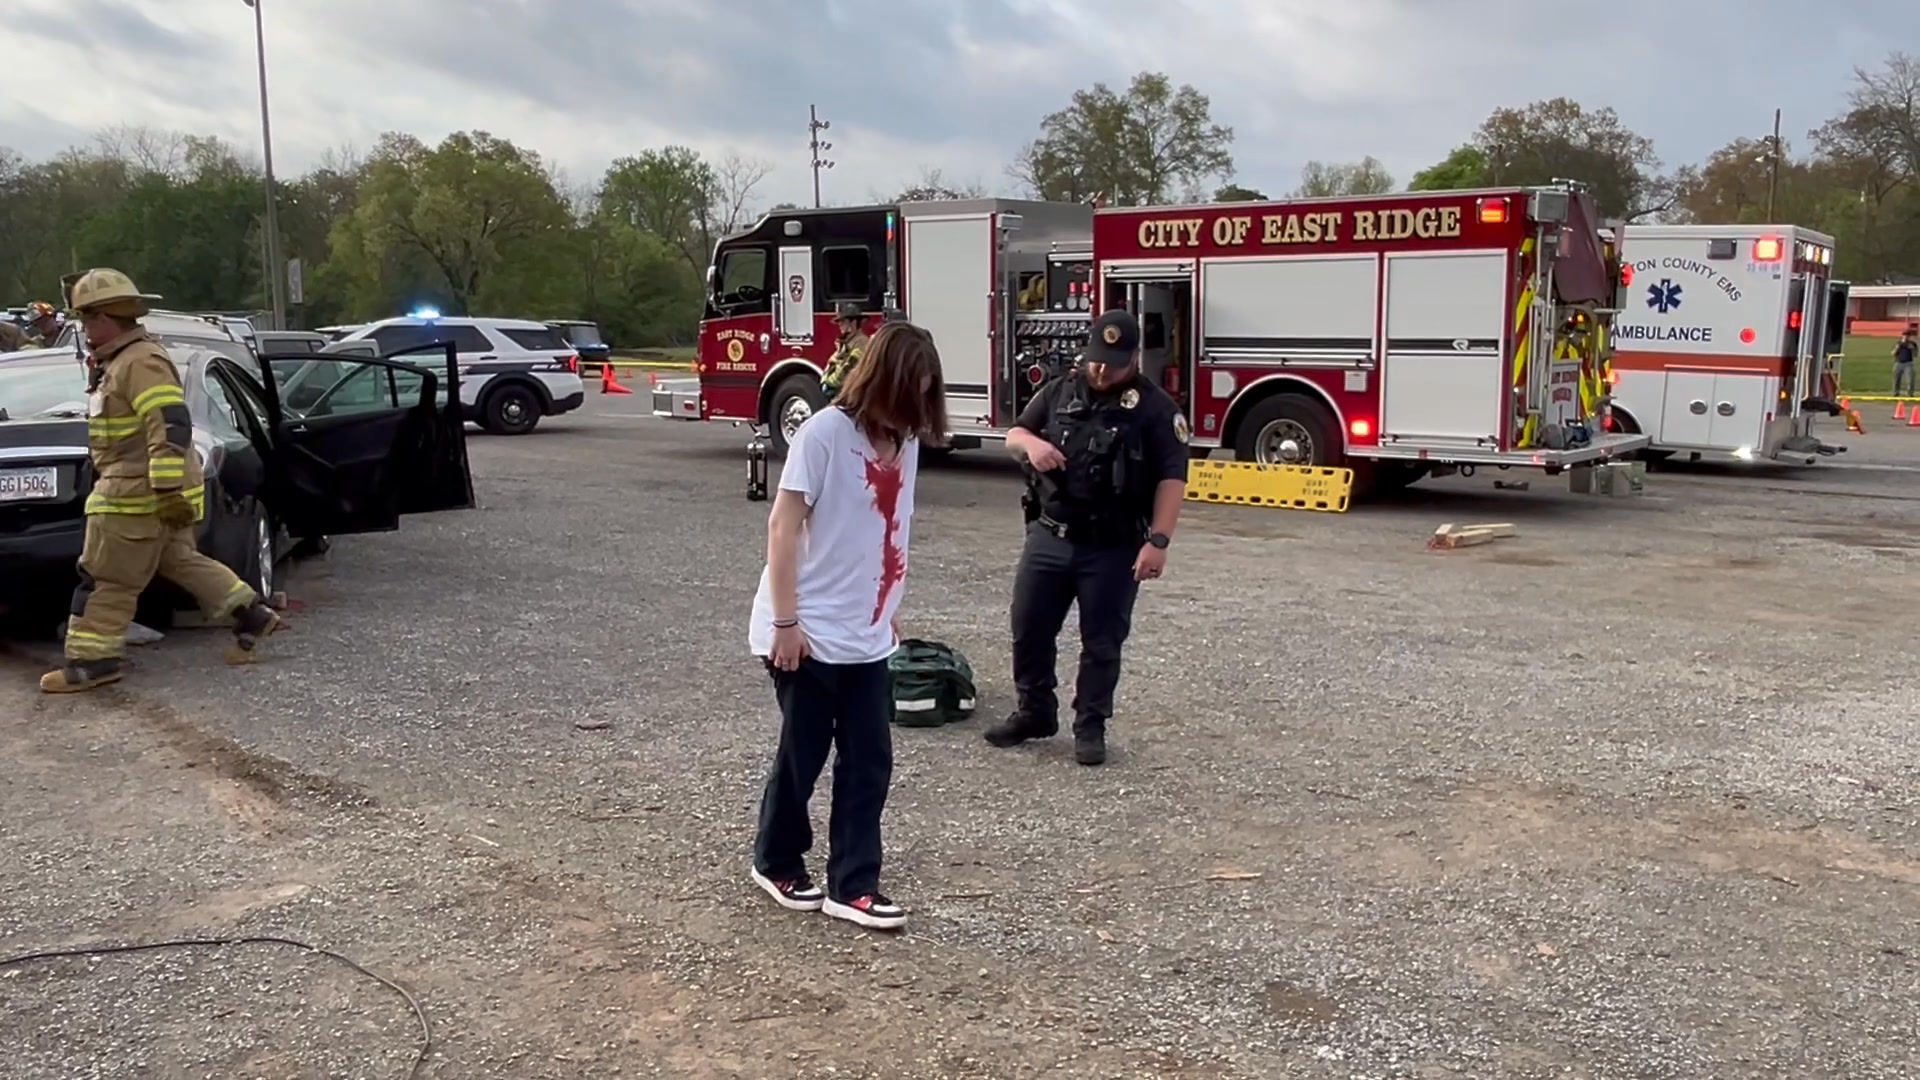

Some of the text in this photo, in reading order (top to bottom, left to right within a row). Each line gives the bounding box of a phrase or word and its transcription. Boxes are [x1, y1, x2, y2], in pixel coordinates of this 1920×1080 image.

[1138, 206, 1461, 247] CITY OF EAST RIDGE
[1662, 257, 1718, 280] COUNTY
[1716, 276, 1742, 302] EMS
[734, 329, 755, 342] RIDGE
[1612, 325, 1713, 341] AMBULANCE
[716, 362, 757, 371] FIRE RESCUE
